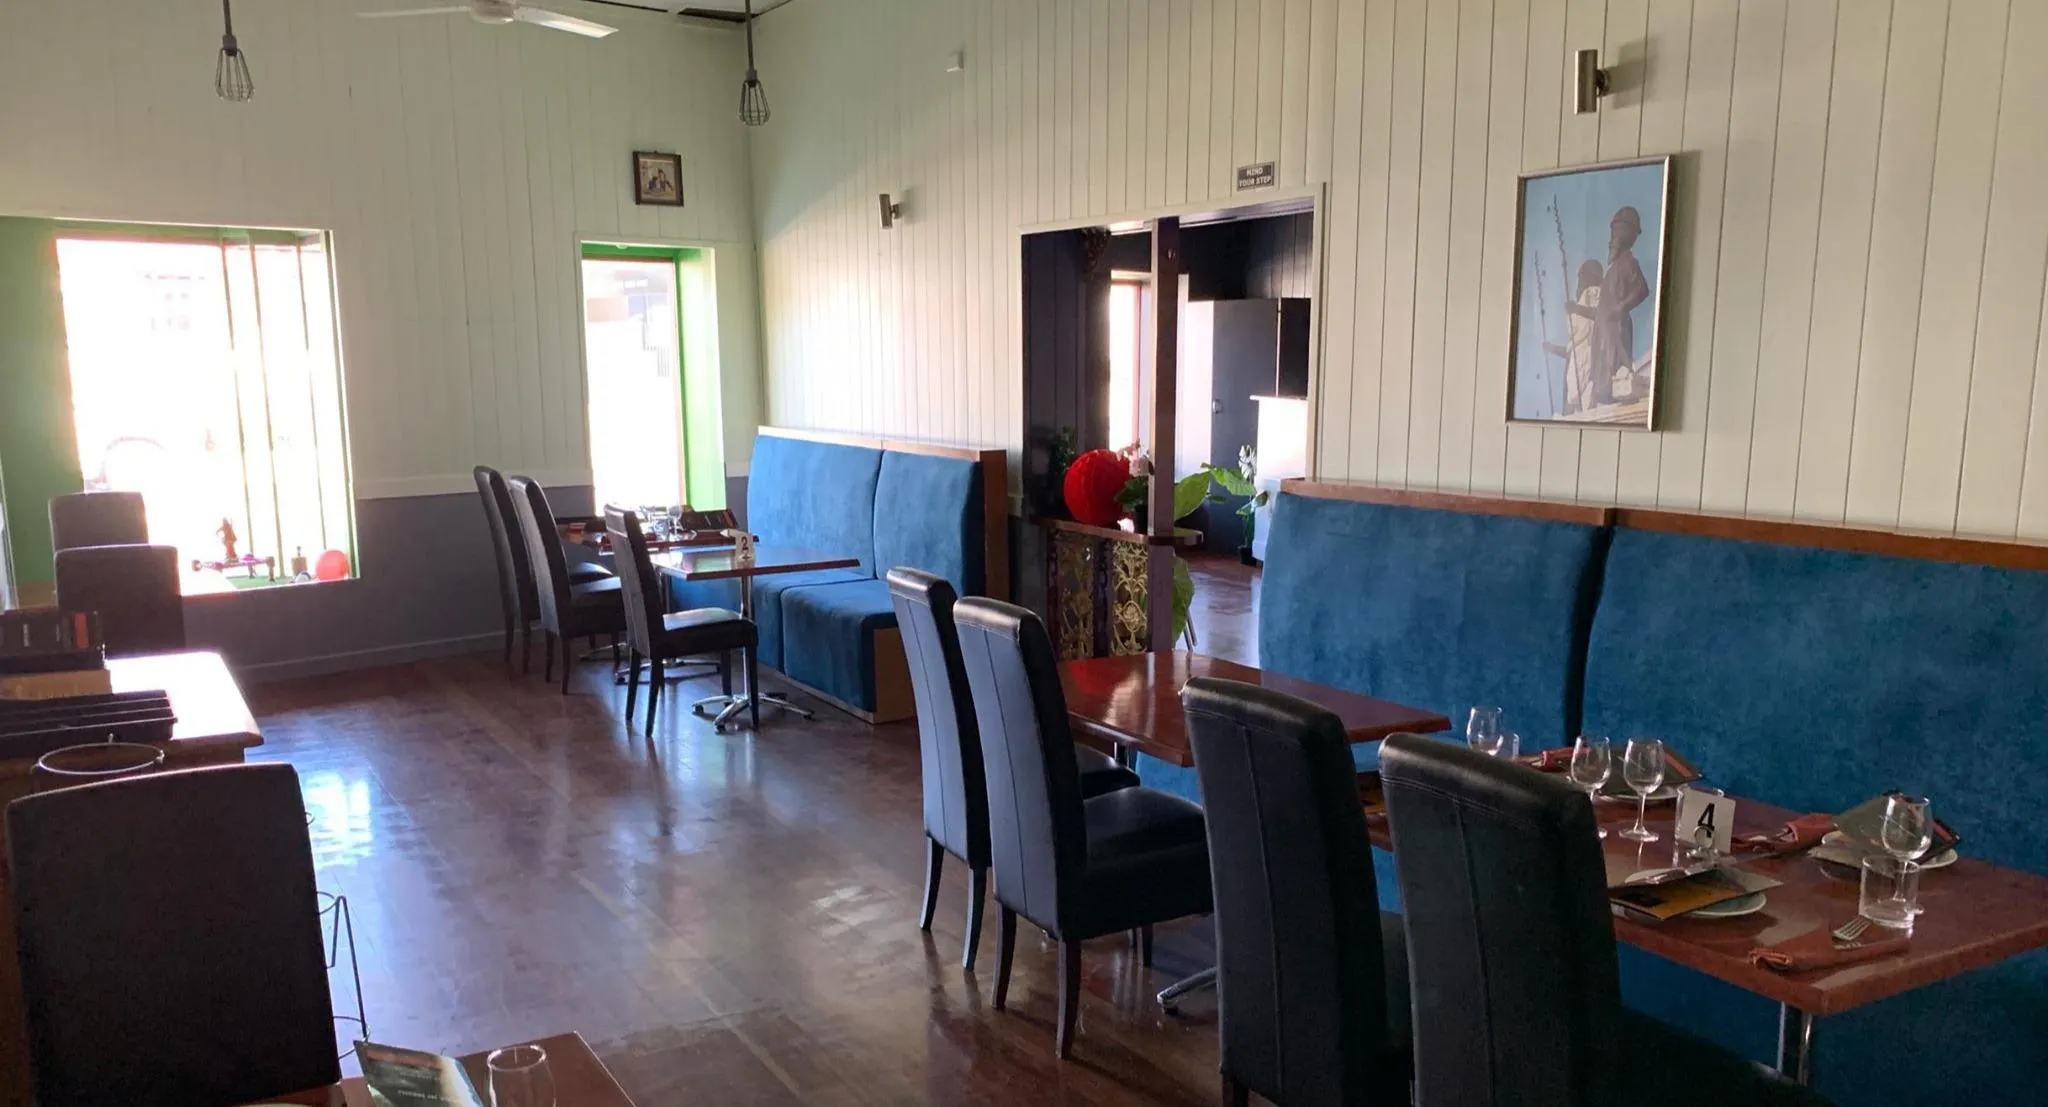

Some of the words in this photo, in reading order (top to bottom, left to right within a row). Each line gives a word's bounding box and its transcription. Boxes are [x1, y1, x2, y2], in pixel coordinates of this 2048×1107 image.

[1246, 167, 1264, 176] MIND
[1239, 177, 1255, 188] YOUR
[1256, 175, 1272, 185] STEP
[741, 535, 749, 551] 2
[1697, 803, 1716, 838] 4
